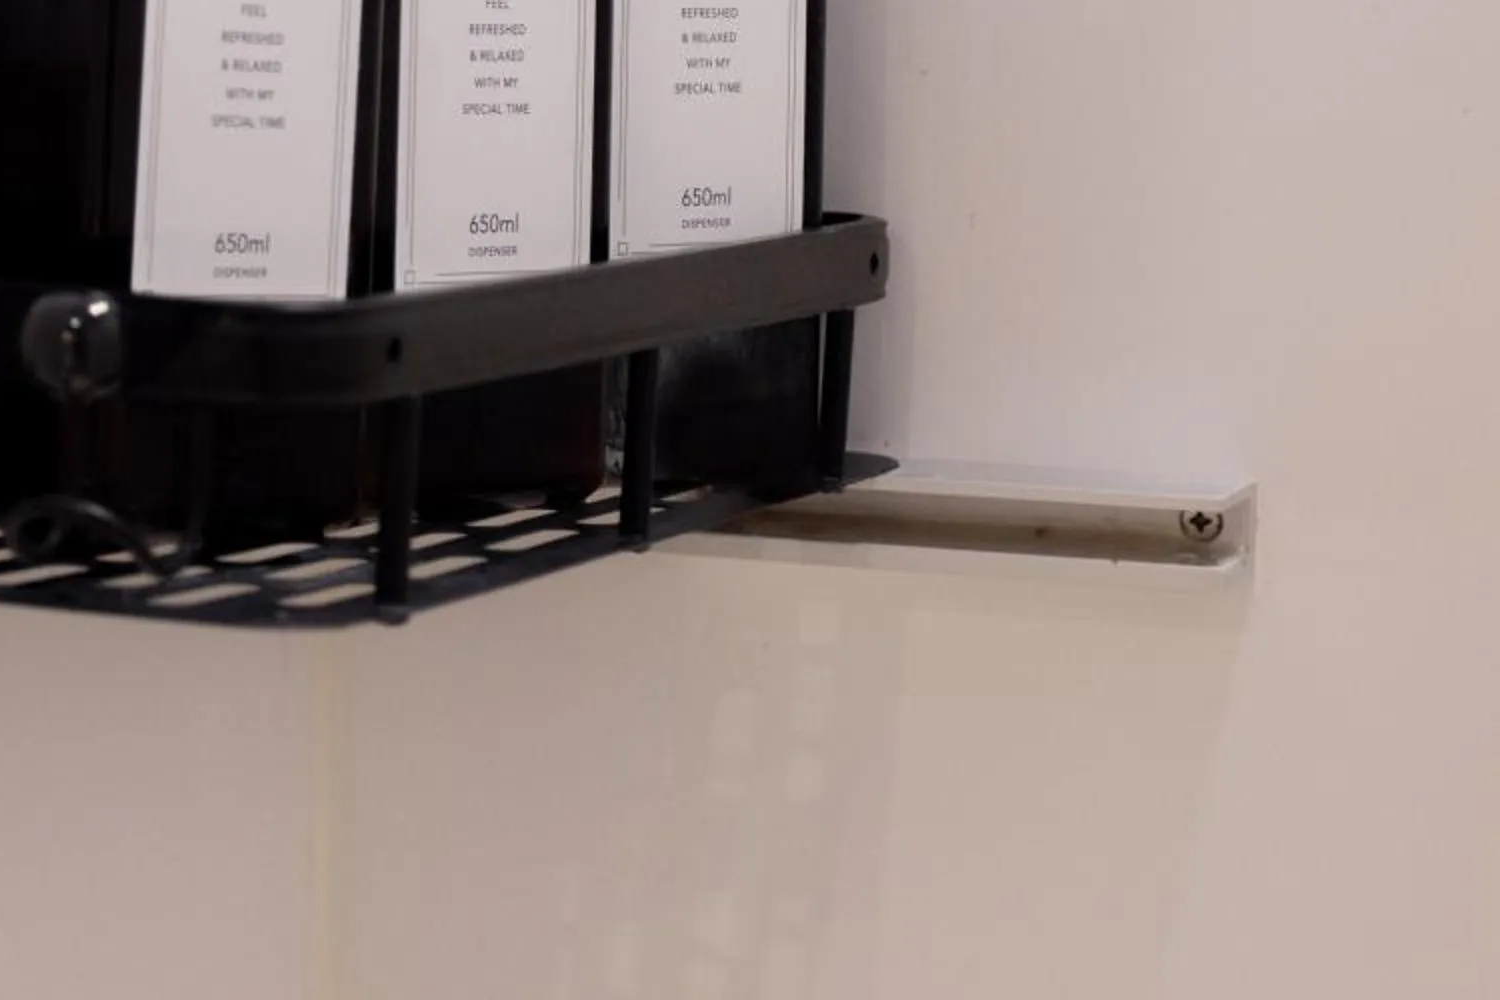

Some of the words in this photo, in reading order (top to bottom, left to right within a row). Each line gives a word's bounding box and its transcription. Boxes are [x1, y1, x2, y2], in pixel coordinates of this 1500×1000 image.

[681, 8, 739, 19] REFRESHED
[468, 24, 527, 36] REFRESHED
[692, 32, 737, 44] RELAXED
[480, 49, 524, 62] RELAXED
[686, 58, 713, 68] WITH
[715, 58, 731, 68] MY
[474, 77, 500, 88] WITH
[503, 77, 518, 88] MY
[674, 82, 715, 95] SPECIAL
[719, 82, 741, 93] TIME
[462, 103, 502, 115] SPECIAL
[506, 103, 530, 114] TIME
[680, 187, 731, 207] 650ml
[469, 213, 519, 234] 650ml
[681, 217, 731, 229] DISPENSER
[214, 232, 270, 254] 650ml
[468, 245, 517, 257] DISPENSER
